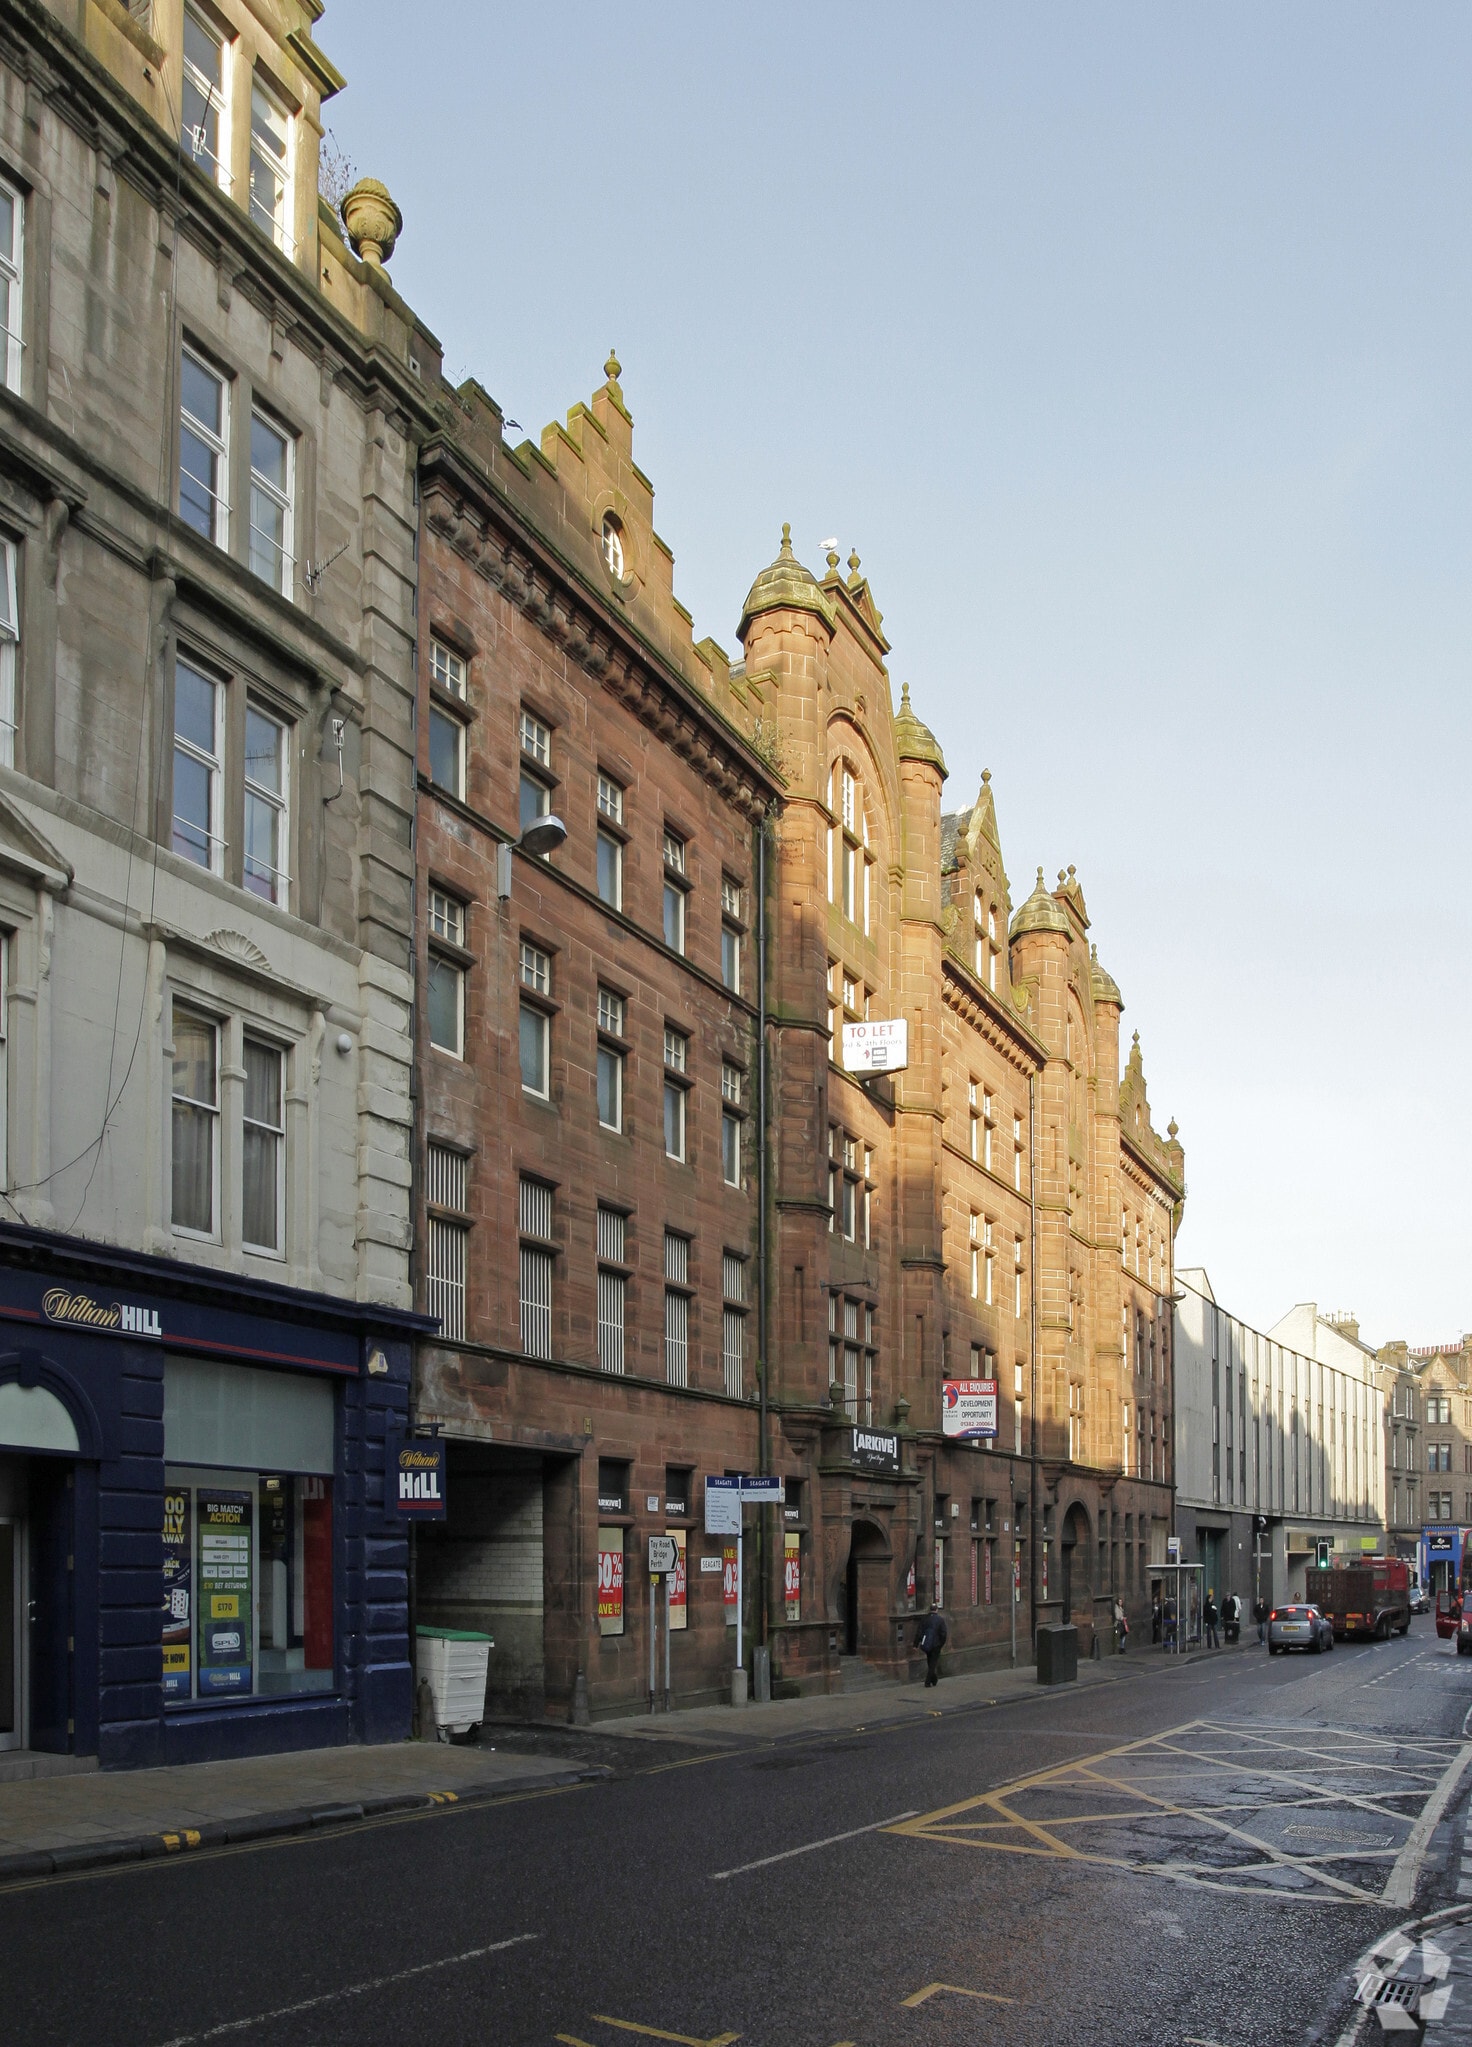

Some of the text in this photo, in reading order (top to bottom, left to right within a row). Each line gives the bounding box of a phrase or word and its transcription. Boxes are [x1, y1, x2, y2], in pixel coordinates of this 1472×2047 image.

[850, 1025, 894, 1038] TO LET
[42, 1287, 162, 1336] William HILL
[959, 1383, 994, 1394] ALL ENQUIRIES
[399, 1449, 440, 1469] William
[399, 1472, 440, 1499] HILL
[207, 1503, 244, 1515] BIG MATCH
[161, 1514, 185, 1534] ILY
[209, 1513, 241, 1524] ACTION
[650, 1540, 670, 1549] Tay Road
[653, 1550, 667, 1558] Bridge
[650, 1560, 662, 1568] Perth
[702, 1560, 721, 1569] SEAGATE
[224, 1582, 247, 1590] RETURNS
[612, 1574, 622, 1587] OFF
[598, 1603, 613, 1615] AVE
[229, 1672, 241, 1681] HILL
